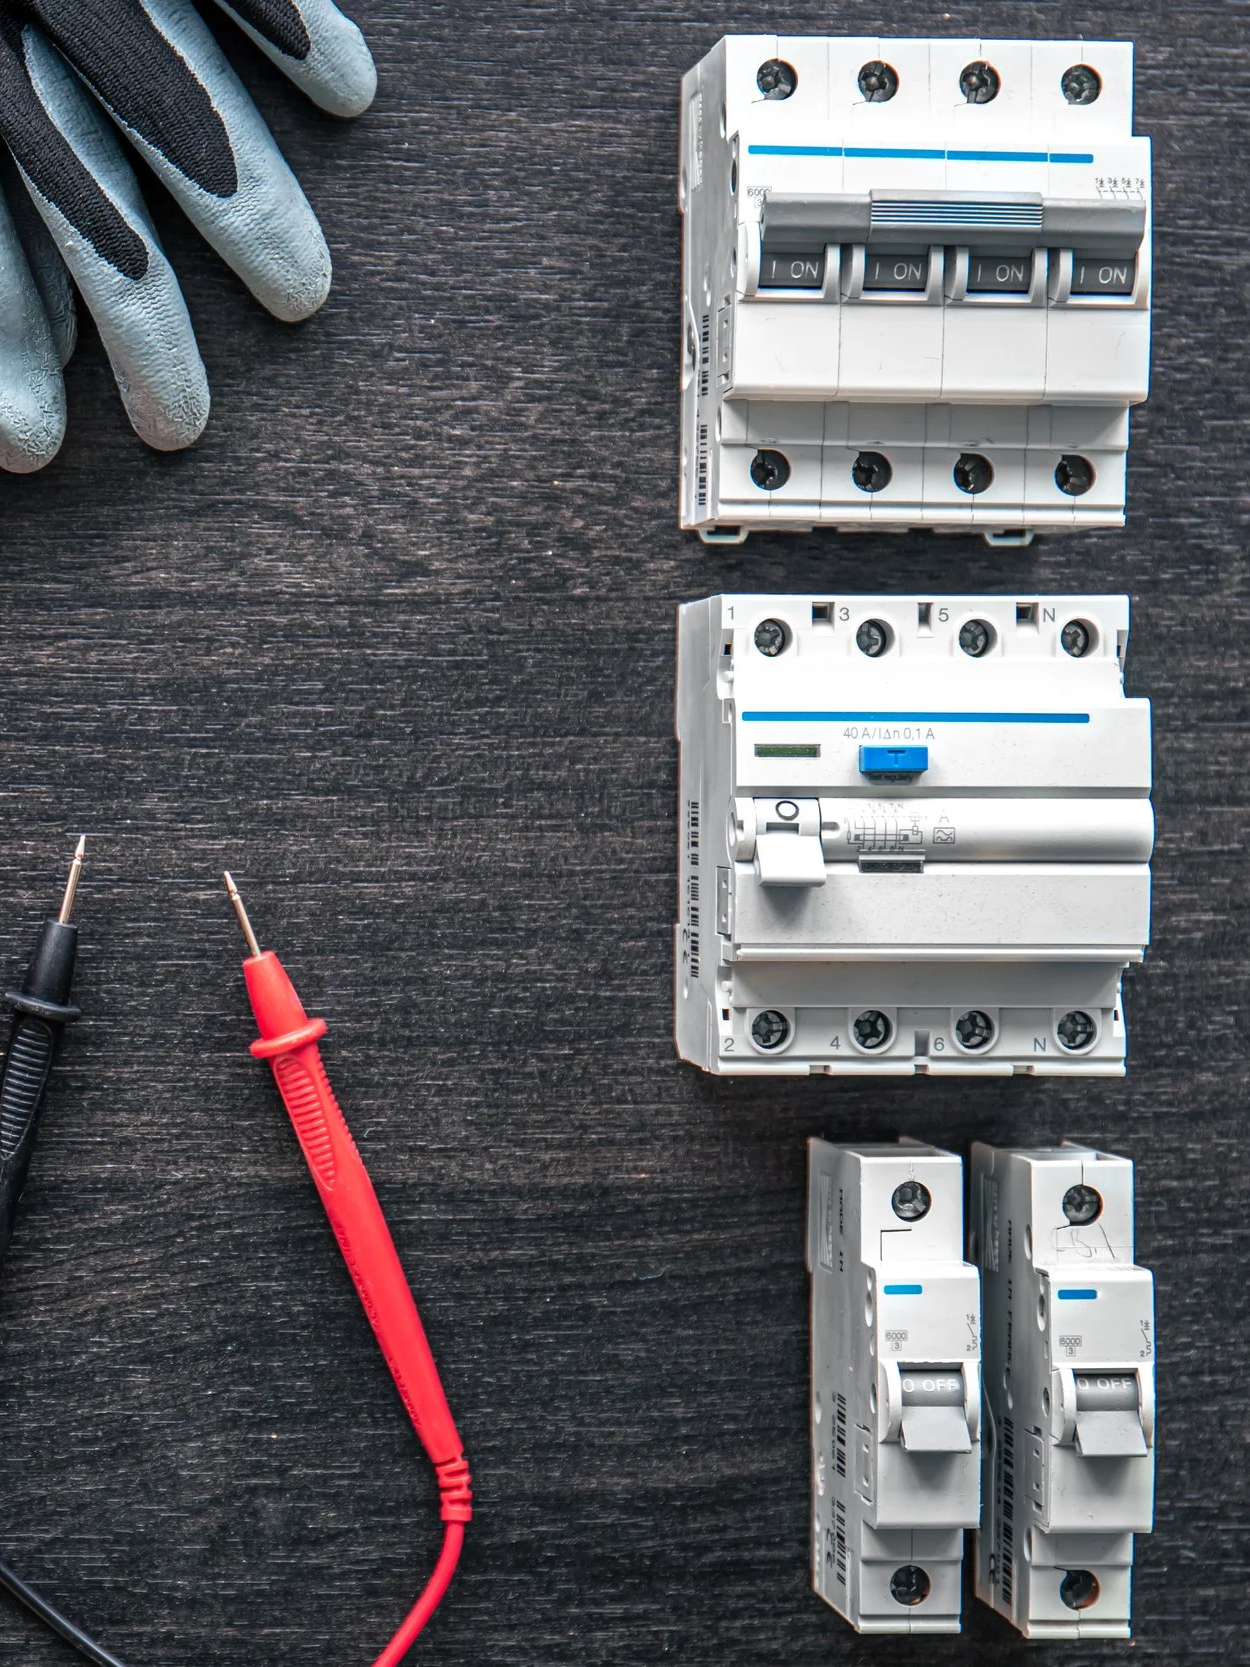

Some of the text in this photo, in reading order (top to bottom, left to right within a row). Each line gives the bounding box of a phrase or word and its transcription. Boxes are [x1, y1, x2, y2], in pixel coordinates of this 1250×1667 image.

[790, 260, 819, 279] ON
[894, 262, 922, 280] ON
[996, 264, 1024, 282] ON
[1098, 266, 1127, 284] ON
[727, 606, 734, 620] 1
[839, 607, 850, 621] 3
[938, 608, 949, 622] 5
[1043, 608, 1056, 622] N
[843, 727, 858, 739] 40
[925, 728, 935, 740] A
[887, 750, 906, 766] T
[724, 1038, 735, 1052] 2
[830, 1036, 841, 1050] 4
[934, 1037, 945, 1051] 6
[1034, 1037, 1046, 1052] N
[886, 1332, 906, 1340] 6000
[1060, 1337, 1081, 1345] 6000
[922, 1379, 959, 1392] OFF
[1097, 1378, 1132, 1389] OFF
